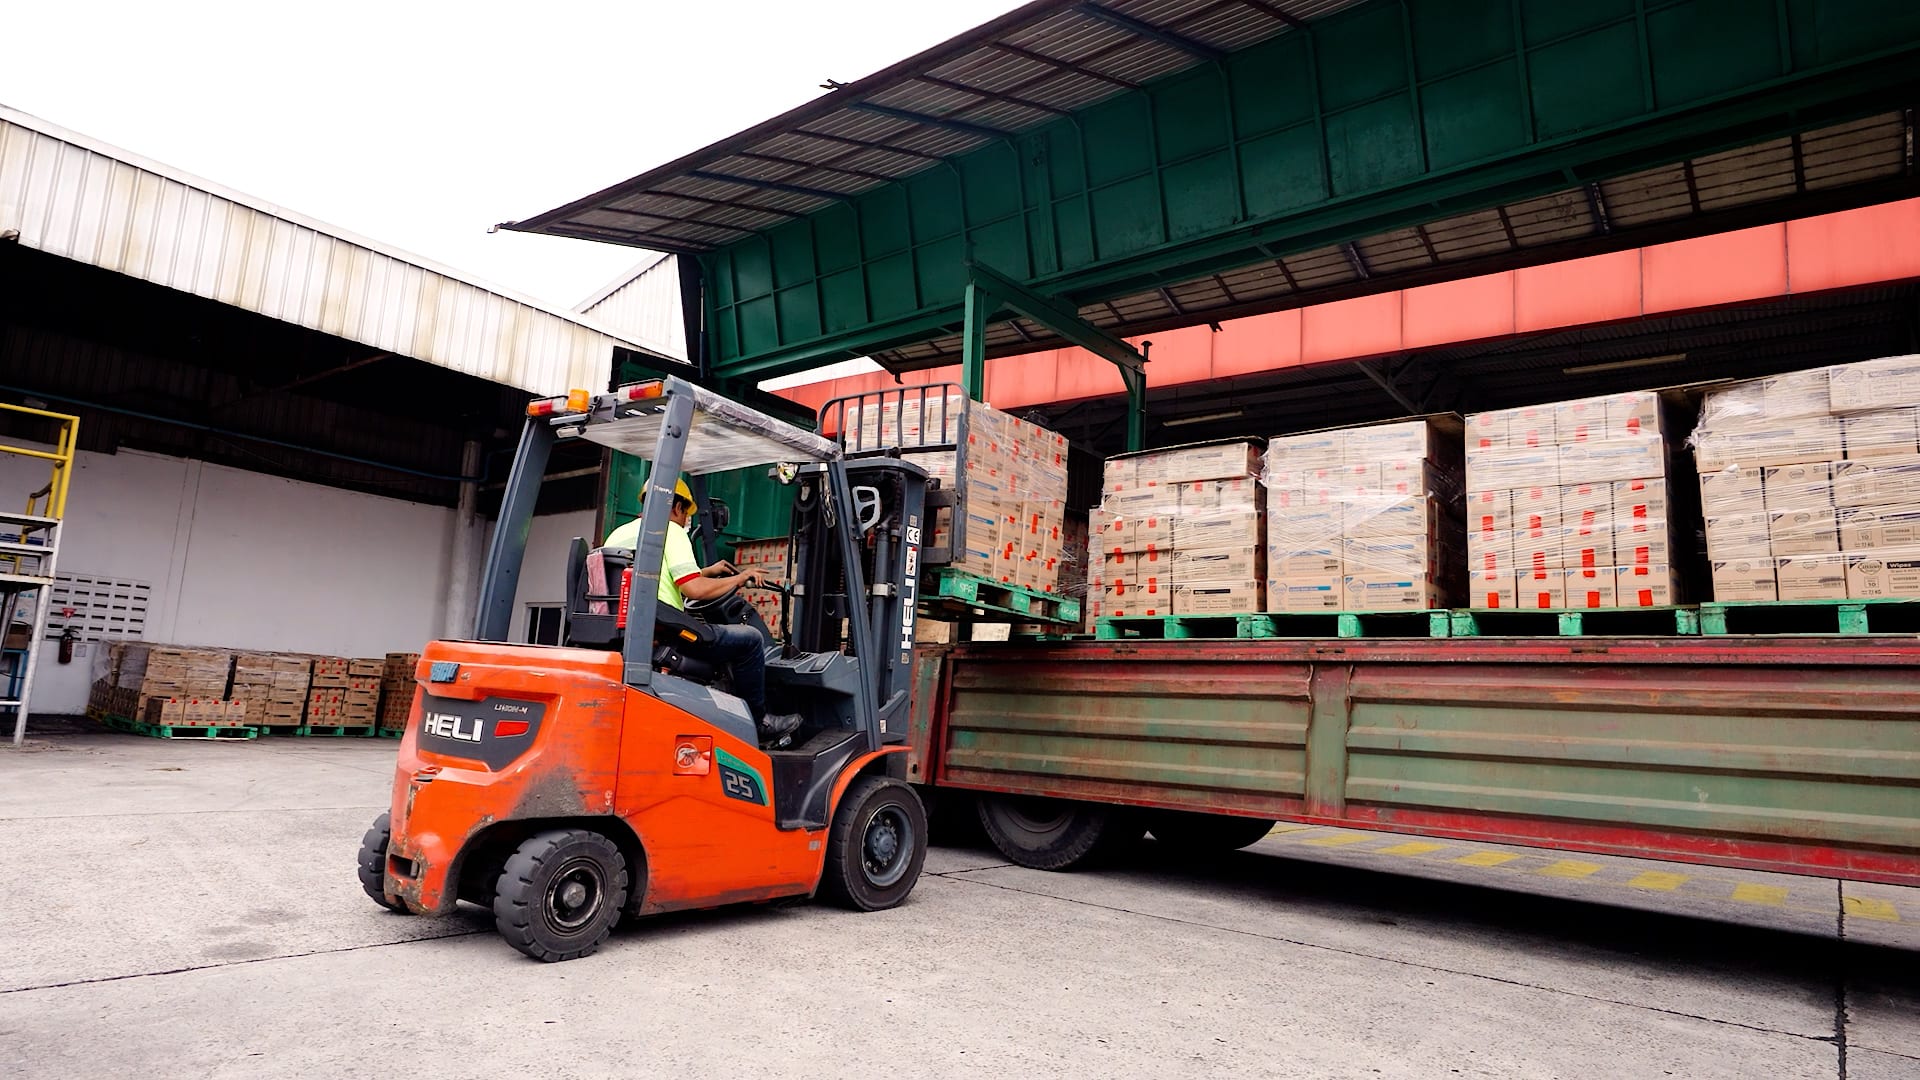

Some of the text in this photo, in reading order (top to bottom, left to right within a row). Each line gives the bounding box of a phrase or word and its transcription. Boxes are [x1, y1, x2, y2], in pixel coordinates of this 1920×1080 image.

[901, 578, 916, 649] HELI
[424, 711, 485, 743] HELI
[725, 771, 754, 798] 25
